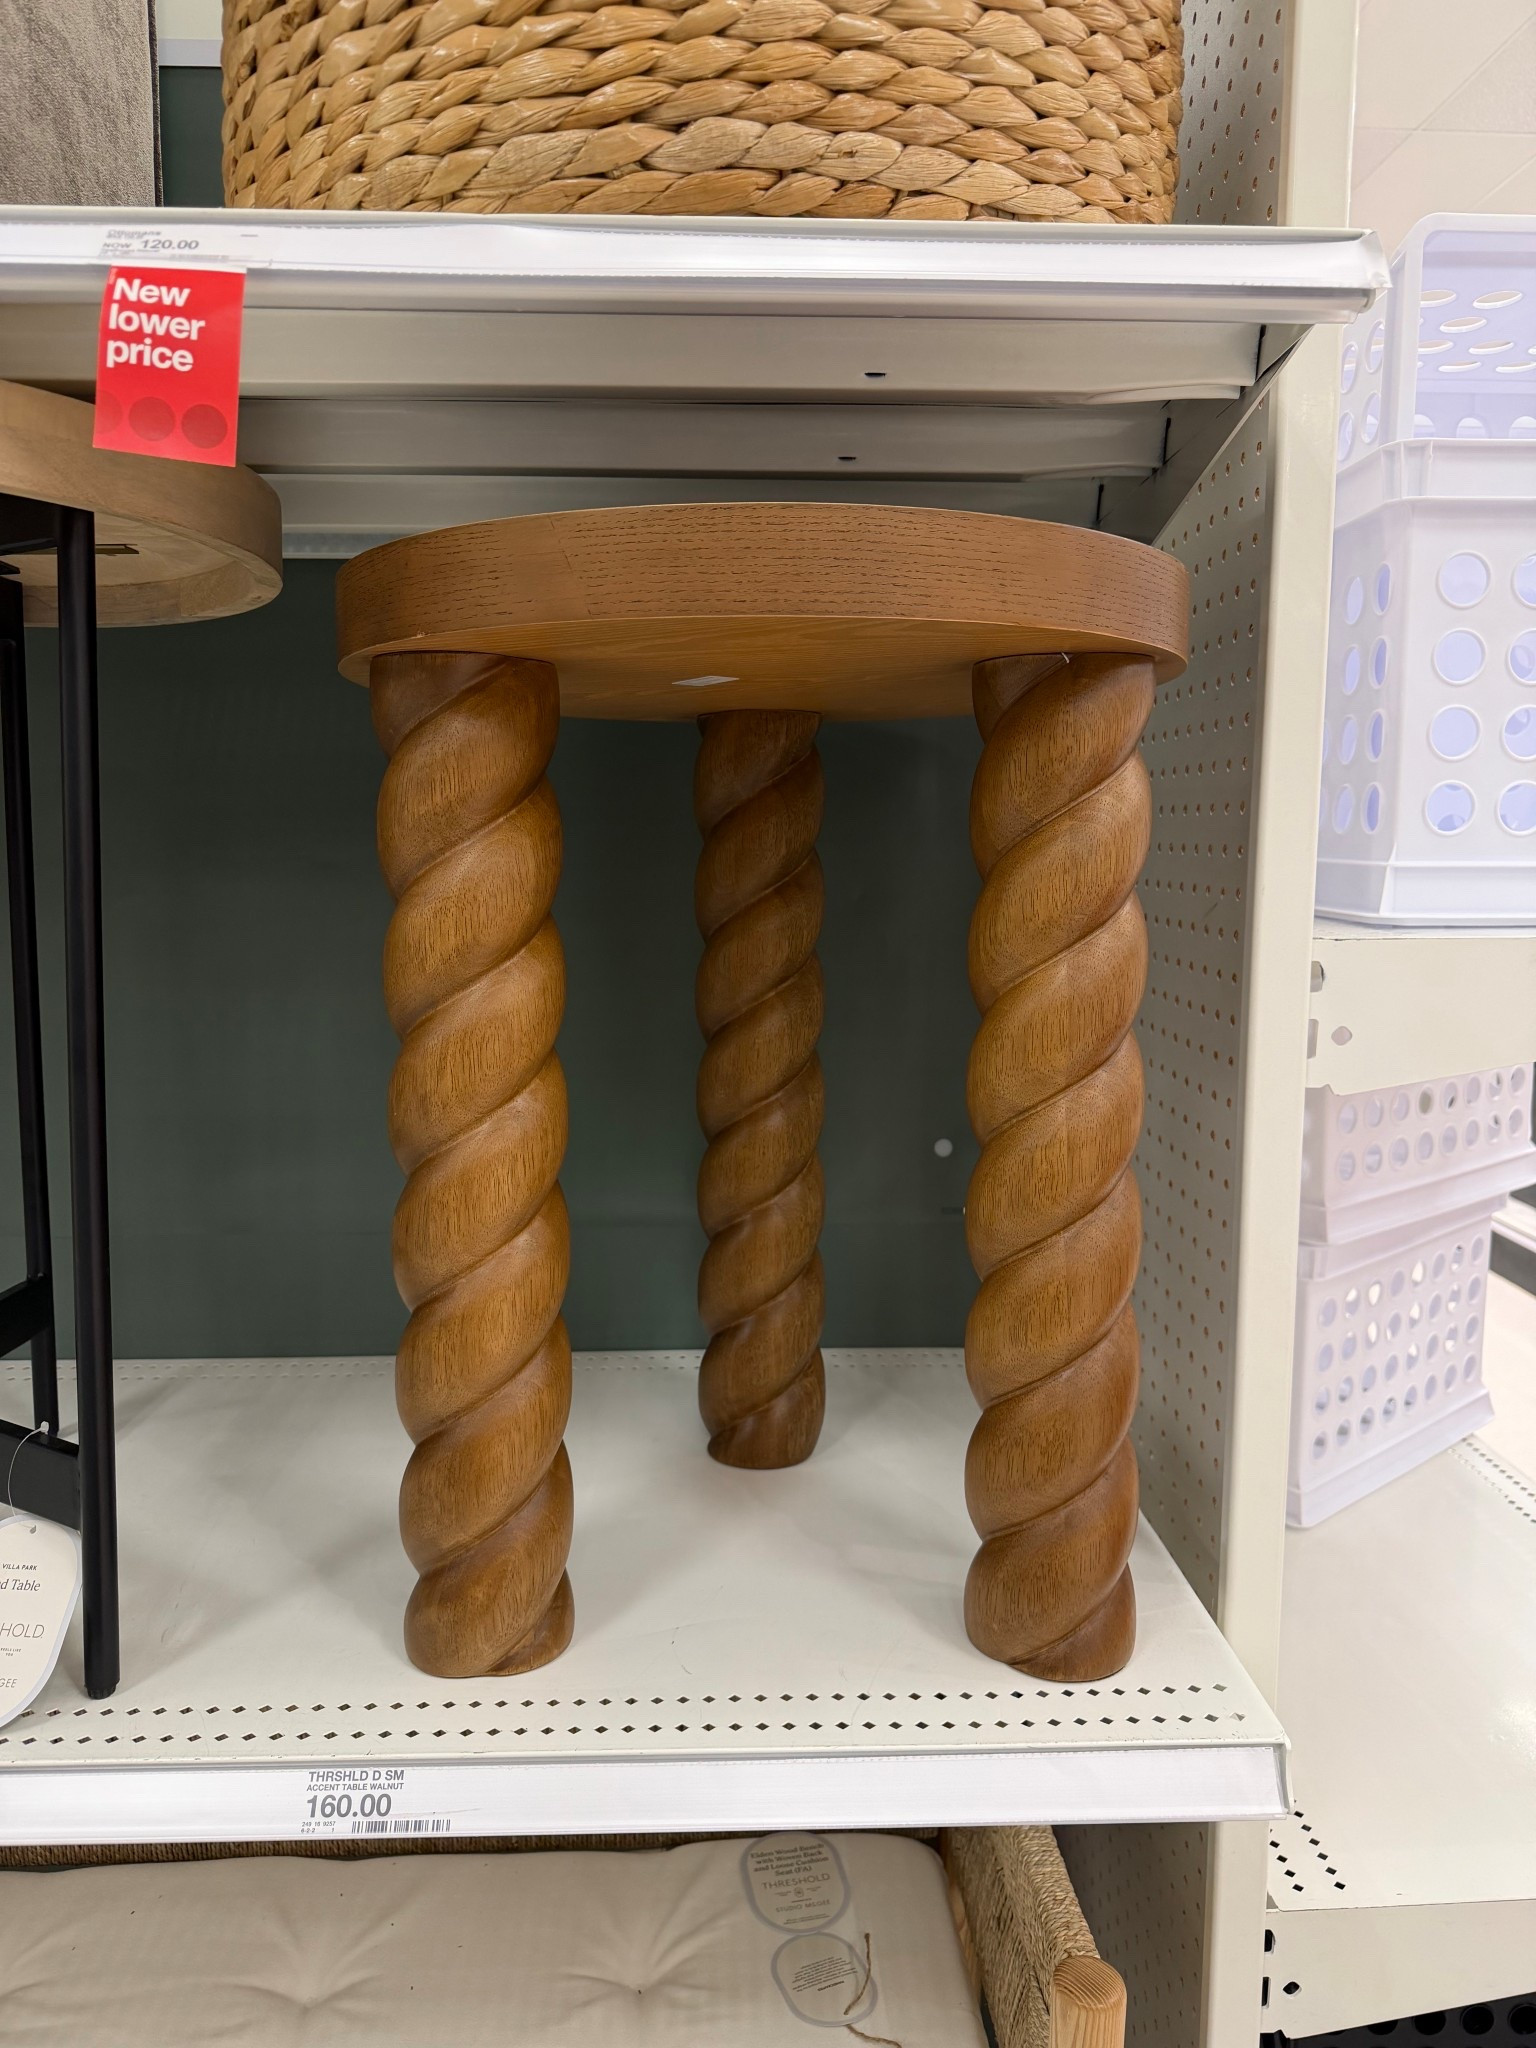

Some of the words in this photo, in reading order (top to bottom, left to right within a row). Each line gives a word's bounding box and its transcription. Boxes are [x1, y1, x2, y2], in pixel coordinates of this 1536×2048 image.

[142, 239, 199, 250] 120.00
[113, 277, 191, 307] New
[109, 303, 206, 340] lower
[106, 337, 194, 372] price
[12, 1579, 41, 1591] Table
[309, 1771, 369, 1782] THRSHLD
[372, 1770, 381, 1781] D
[384, 1770, 405, 1781] SM
[307, 1784, 340, 1792] ACCENT
[342, 1783, 368, 1791] TABLE
[307, 1793, 392, 1818] 160.00
[754, 1864, 769, 1872] and
[771, 1862, 794, 1870] Loose
[796, 1857, 829, 1865] Cushion
[761, 1873, 830, 1889] THRESHOLD
[776, 1904, 803, 1912] STUDIO
